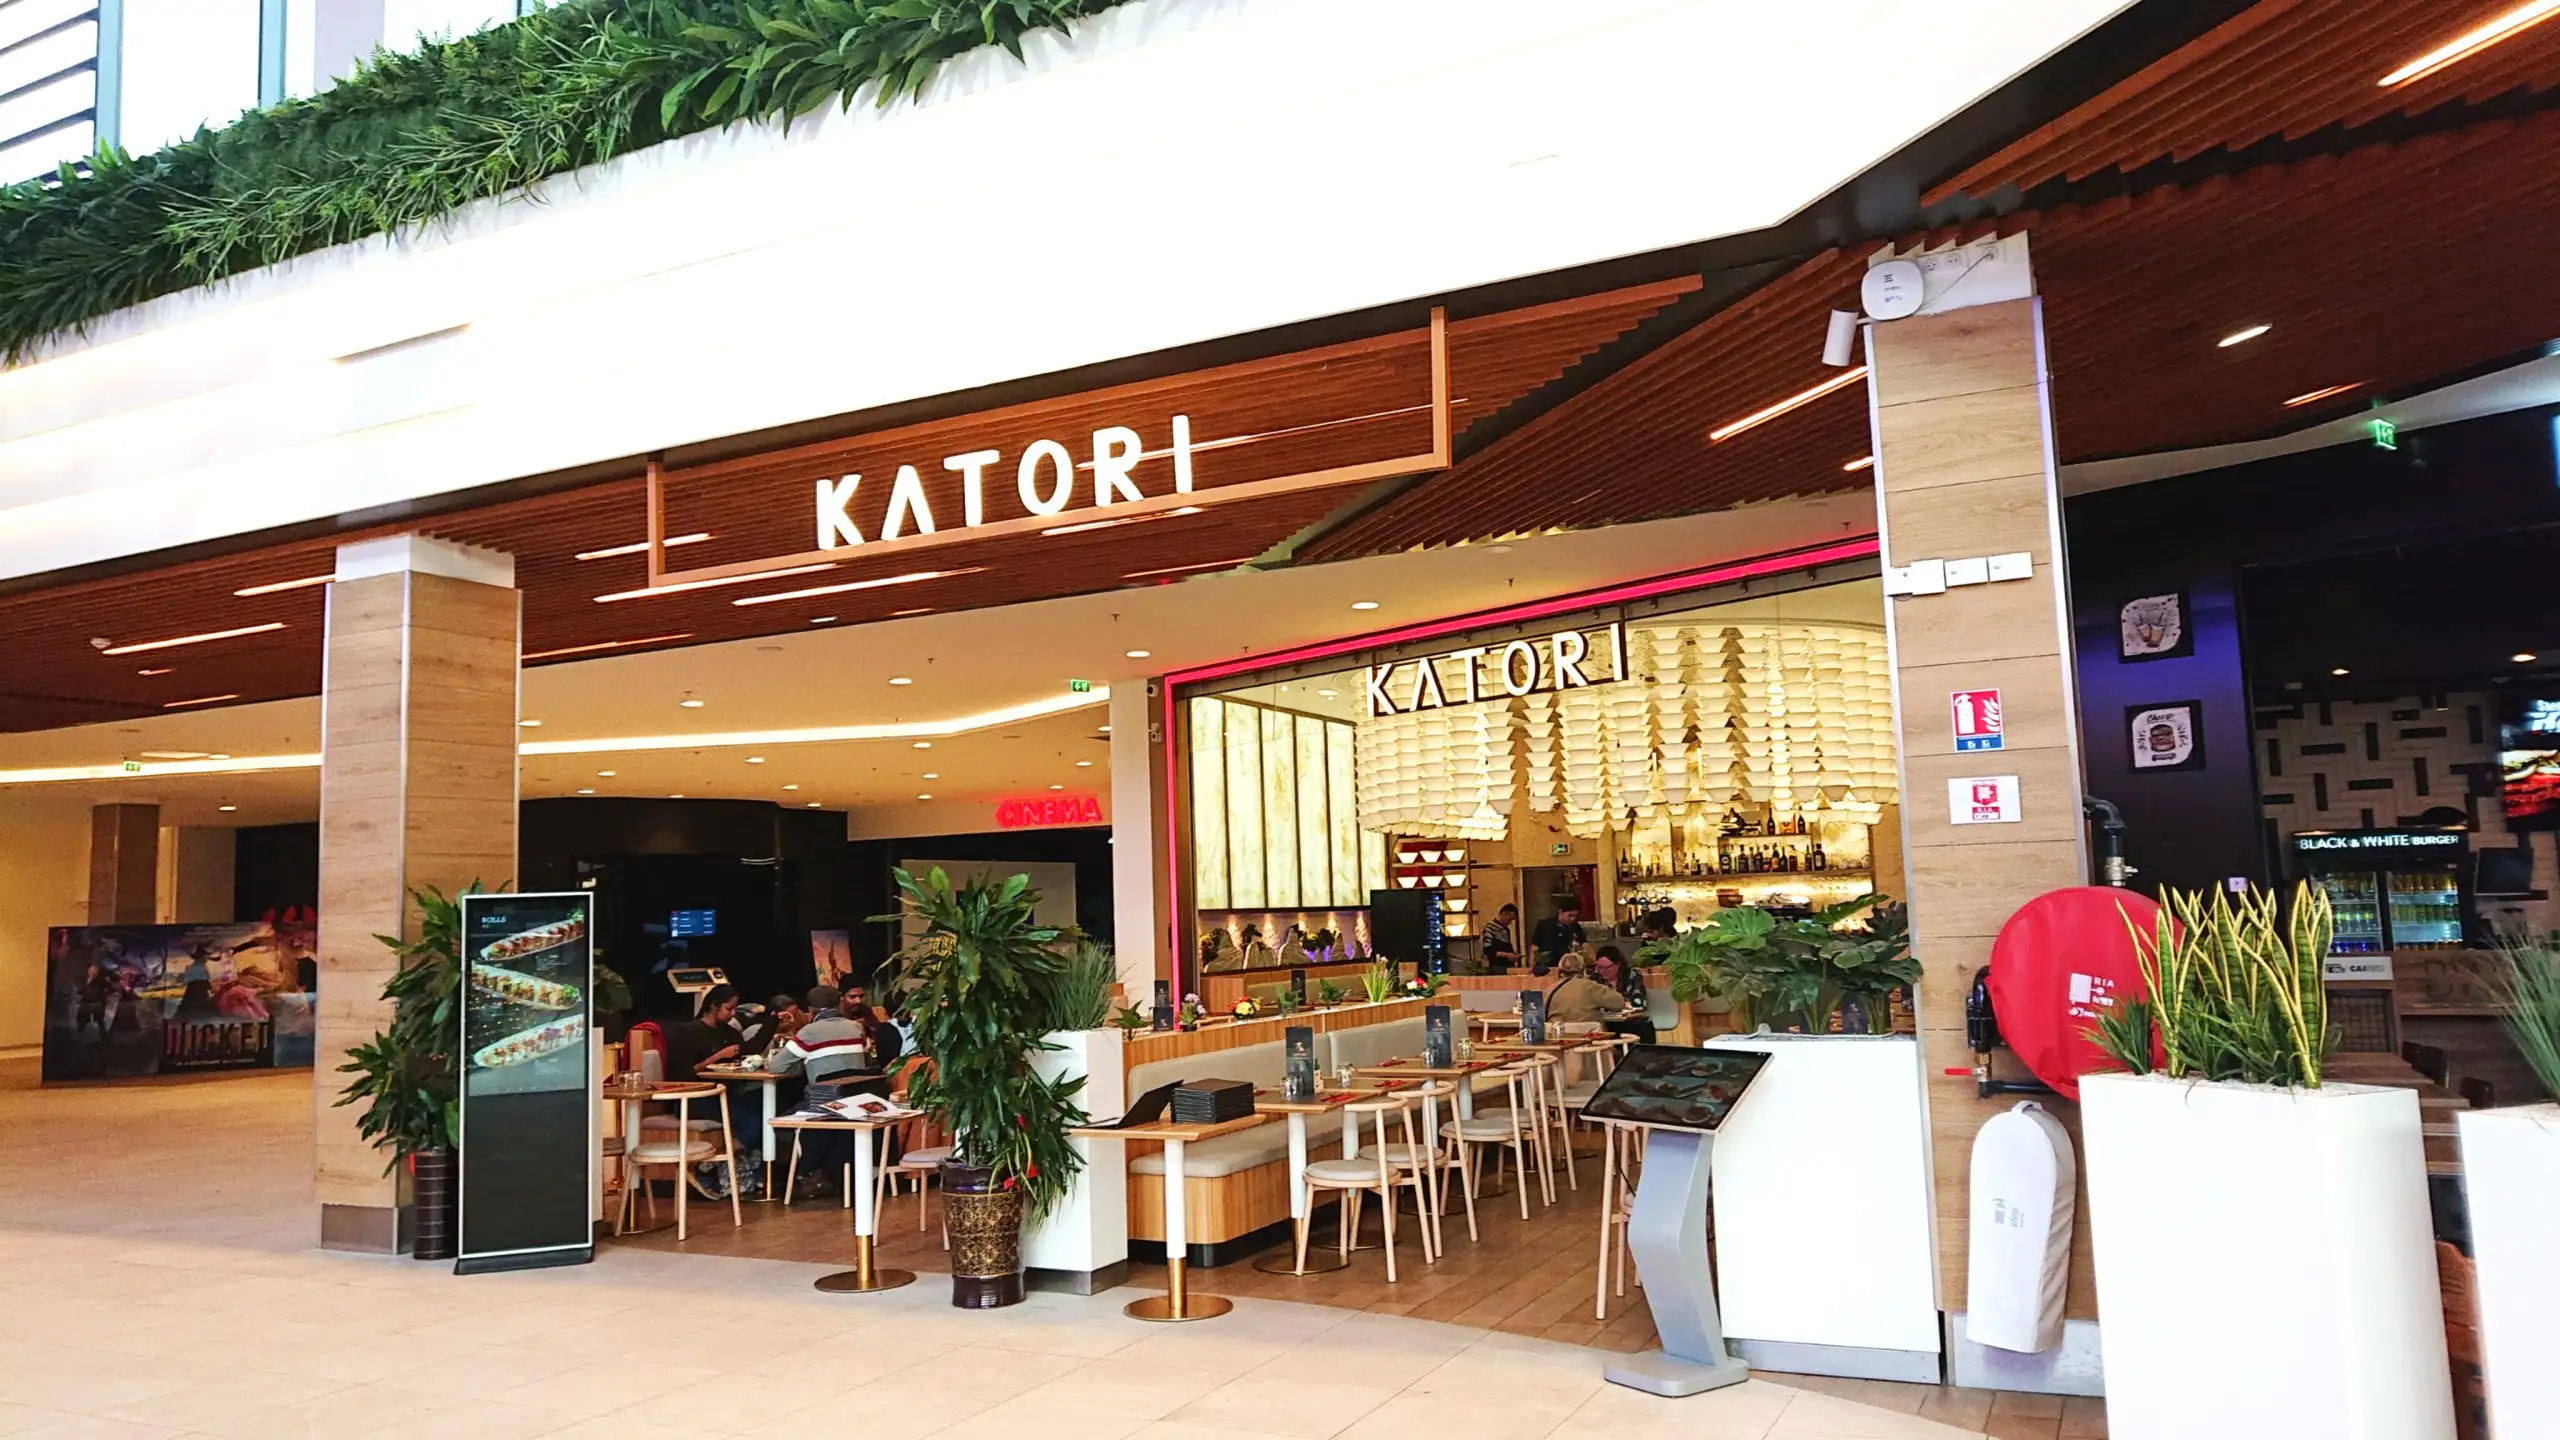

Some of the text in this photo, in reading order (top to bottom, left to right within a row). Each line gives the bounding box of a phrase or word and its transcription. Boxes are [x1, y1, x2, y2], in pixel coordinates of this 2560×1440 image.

[816, 414, 1193, 550] KATORI
[1366, 622, 1628, 717] KATORI
[996, 797, 1102, 828] CINEMA
[2300, 835, 2459, 850] BLACK & WHITE BURGER
